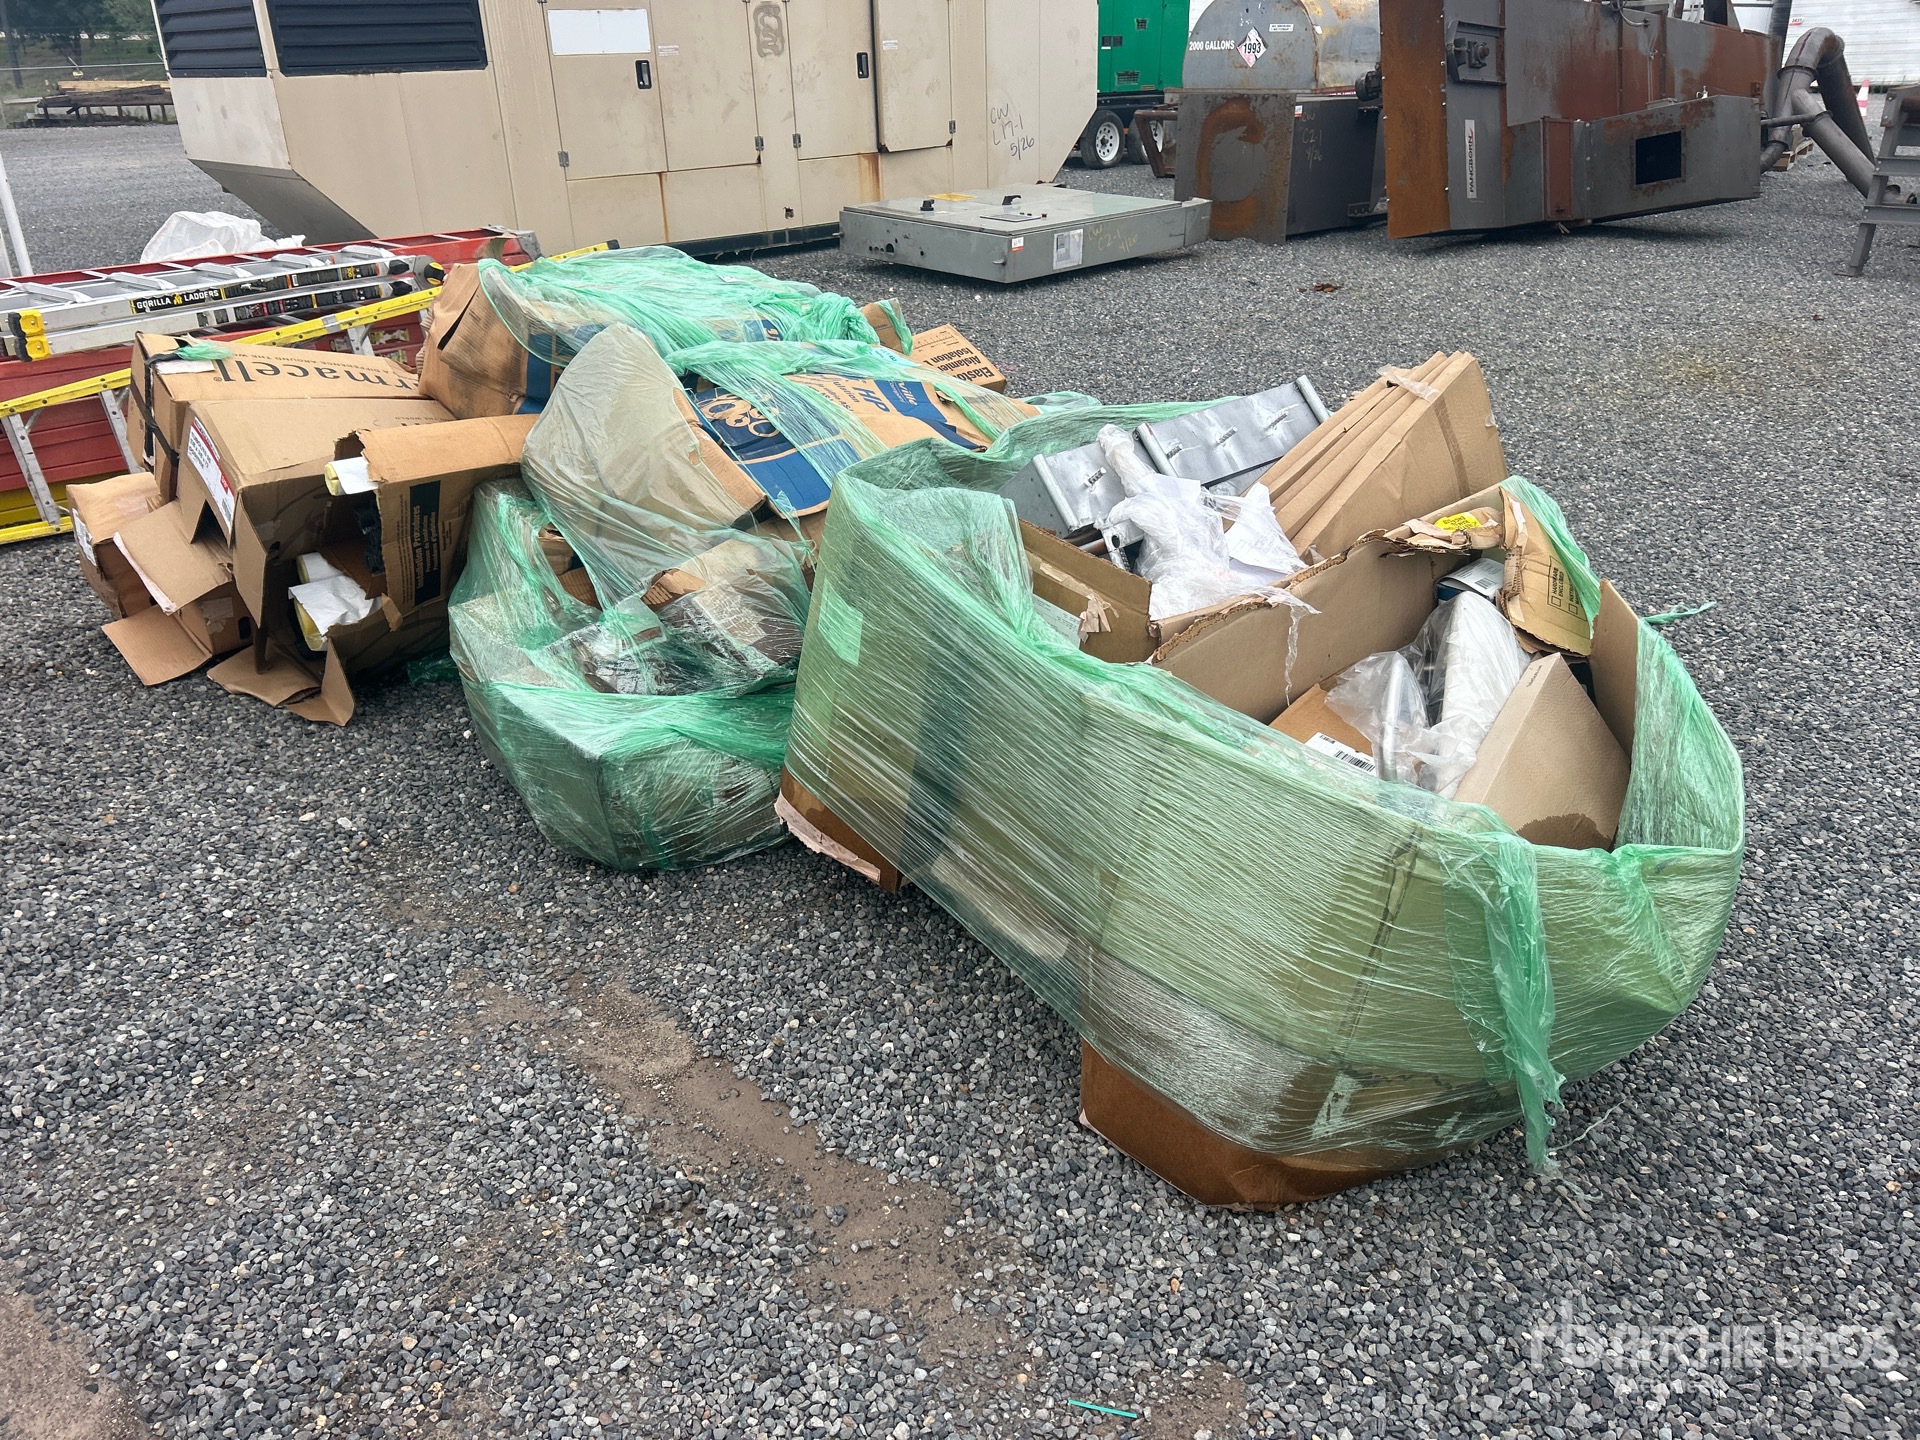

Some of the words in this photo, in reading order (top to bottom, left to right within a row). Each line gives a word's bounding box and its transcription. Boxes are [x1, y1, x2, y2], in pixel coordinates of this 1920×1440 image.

[1188, 41, 1204, 51] 2000
[1204, 40, 1235, 50] GALLONS
[1243, 42, 1261, 54] 1993
[990, 103, 1009, 124] CW
[1009, 135, 1035, 161] 5/26
[1467, 135, 1475, 193] PANGBORN
[136, 297, 172, 309] GORILLA
[183, 289, 219, 302] LADDERS
[930, 347, 974, 364] Isolation
[851, 386, 890, 413] HP
[412, 505, 422, 548] Procedures
[414, 547, 424, 589] Installation
[1551, 566, 1559, 595] HARDWARE
